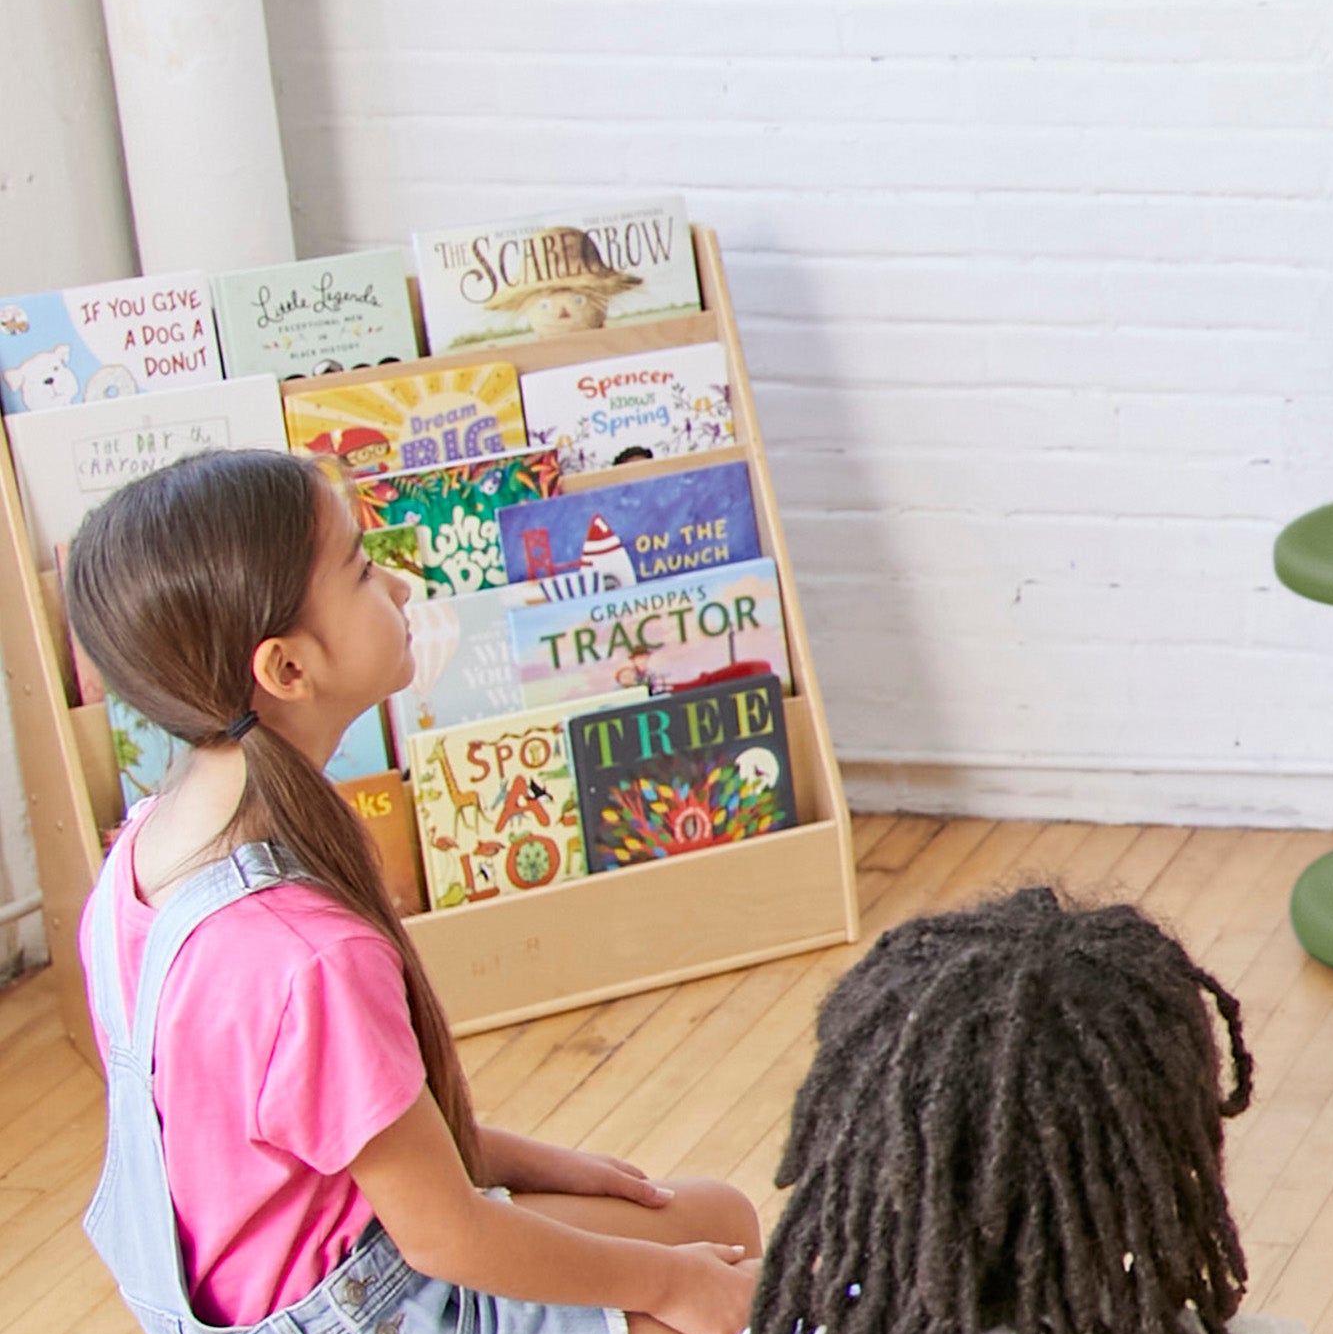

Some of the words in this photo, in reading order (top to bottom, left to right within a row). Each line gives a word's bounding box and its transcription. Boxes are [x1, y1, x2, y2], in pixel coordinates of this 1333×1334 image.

[434, 241, 471, 269] THE
[460, 217, 675, 304] SCARECROW
[80, 301, 100, 324] IF
[108, 296, 145, 318] YOU
[152, 289, 202, 312] GIVE
[251, 285, 310, 328] Little
[312, 272, 382, 313] Legends
[124, 329, 136, 350] A
[142, 322, 185, 345] DOG
[193, 319, 204, 340] A
[144, 346, 207, 377] DONUT
[577, 369, 674, 399] Spencer
[410, 403, 477, 434] Dream
[591, 404, 670, 437] Spring
[136, 431, 172, 454] DAY
[400, 416, 505, 470] BIG
[635, 532, 670, 553] ON
[680, 519, 728, 546] THE
[639, 545, 730, 578] LAUNCH
[590, 584, 707, 623] GRANDPA'S
[539, 594, 760, 670] TRACTOR
[583, 687, 775, 769] TREE
[466, 734, 552, 783] SPO
[494, 774, 551, 834] A
[459, 833, 561, 904] LO
